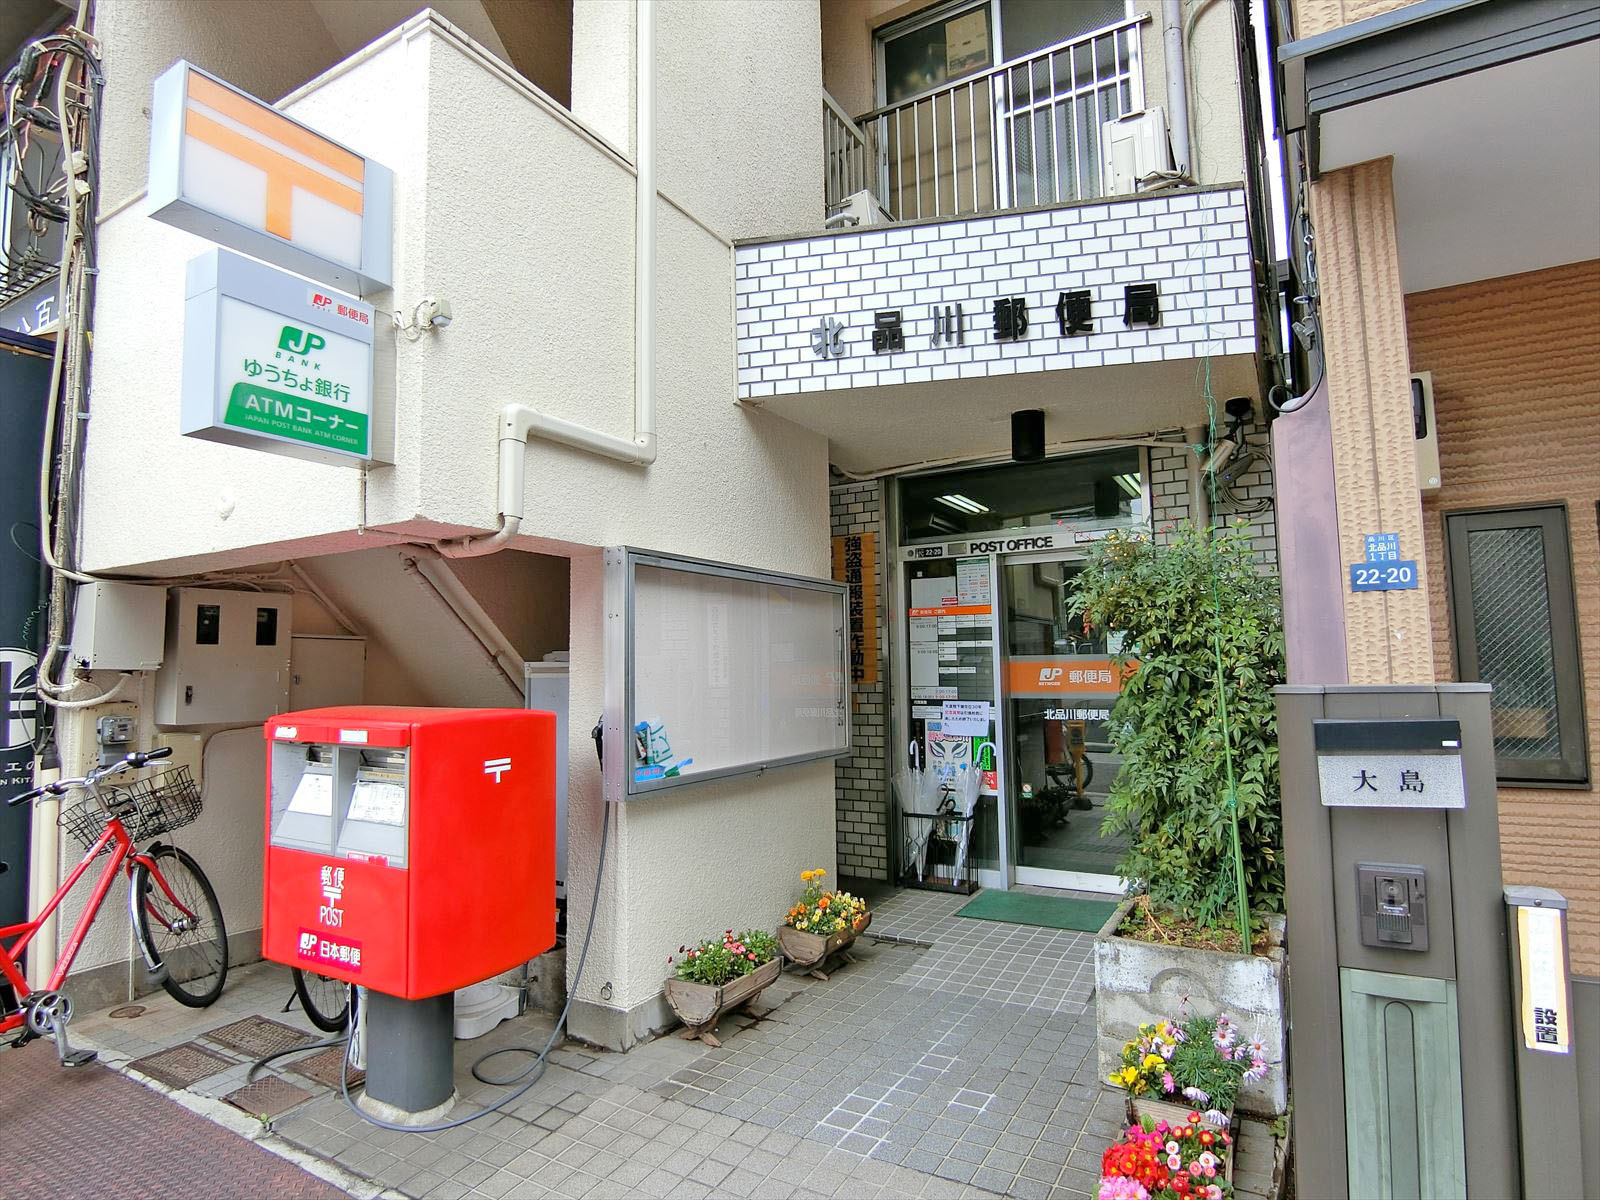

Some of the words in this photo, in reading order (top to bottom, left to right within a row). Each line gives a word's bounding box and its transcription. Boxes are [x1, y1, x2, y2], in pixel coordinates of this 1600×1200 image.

[337, 305, 369, 325] 郵便局
[811, 283, 1161, 359] 北品川郵便局
[278, 325, 326, 356] JP
[275, 351, 321, 371] BANK
[244, 358, 350, 403] ゆうちょ銀行
[245, 394, 359, 430] ATMコーナー
[245, 414, 270, 425] JAPAN
[272, 420, 291, 430] POST
[292, 424, 313, 435] BANK
[315, 429, 331, 440] ATM
[332, 433, 358, 445] CORNER
[970, 541, 1005, 554] POST
[1006, 536, 1054, 551] OFFICE
[1367, 542, 1397, 552] 北品川
[1369, 551, 1397, 561] 1丁目
[1356, 567, 1411, 585] 22-20
[1069, 670, 1112, 684] 郵便局
[1043, 708, 1110, 720] 北品川郵便局
[1352, 769, 1425, 793] 大島
[321, 865, 345, 889] 郵便
[320, 905, 345, 928] POST
[320, 940, 361, 966] 日本郵便
